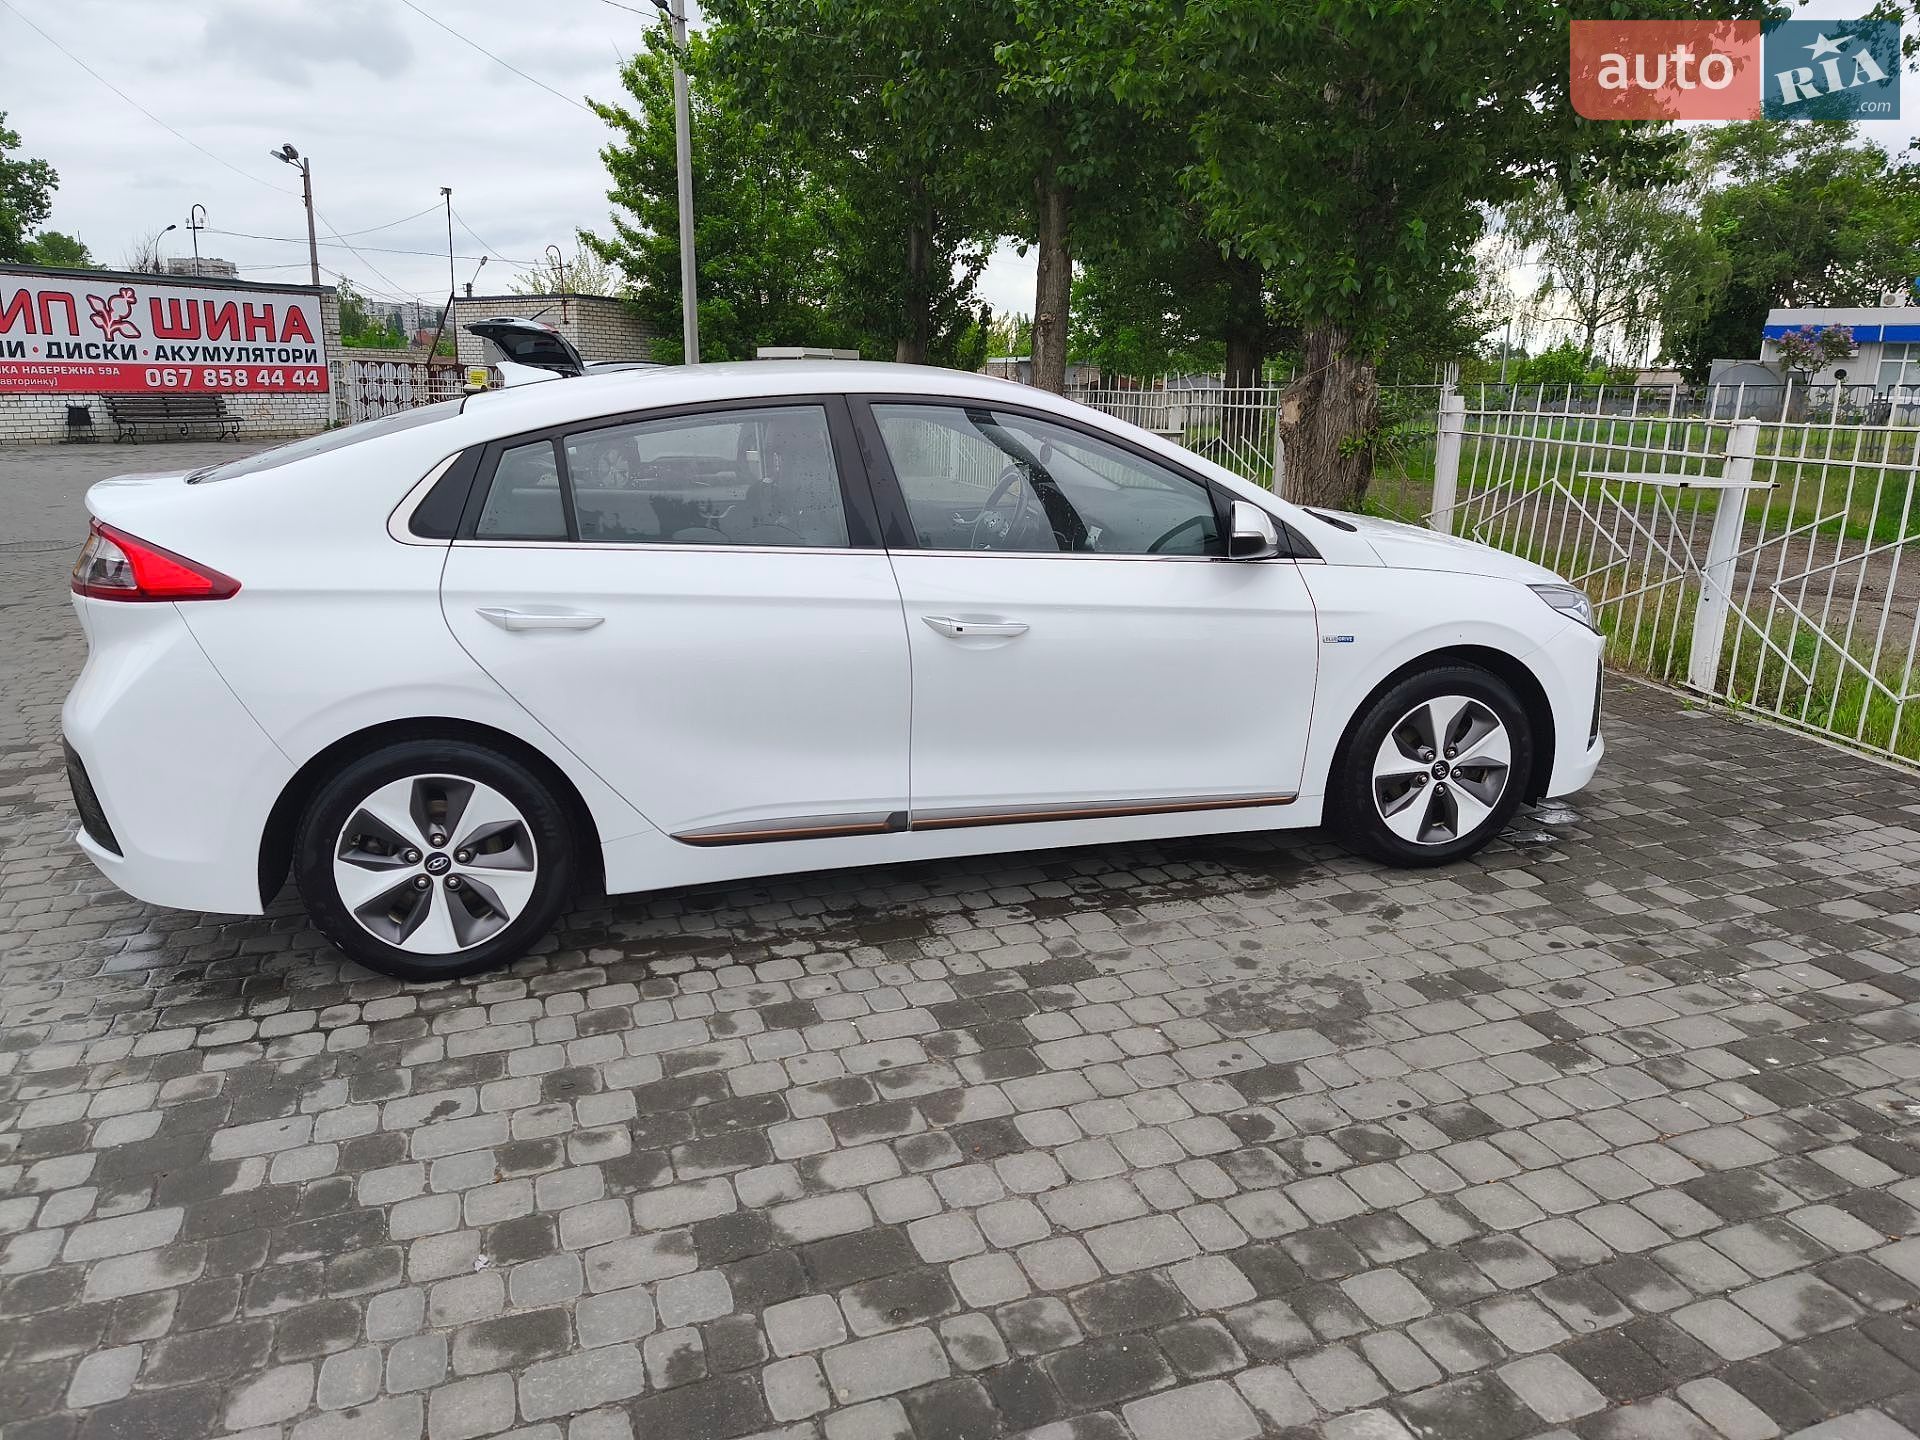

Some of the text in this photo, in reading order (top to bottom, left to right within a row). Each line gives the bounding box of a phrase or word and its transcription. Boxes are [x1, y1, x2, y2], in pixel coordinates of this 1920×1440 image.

[149, 297, 315, 343] ШИНА
[46, 341, 137, 361] ДИСКИ
[154, 345, 318, 364] АКУМУЛЯТОРИ
[0, 366, 18, 374] КА
[22, 366, 95, 375] НАБЕРЕЖНА
[145, 368, 319, 387] 067 858 44 44
